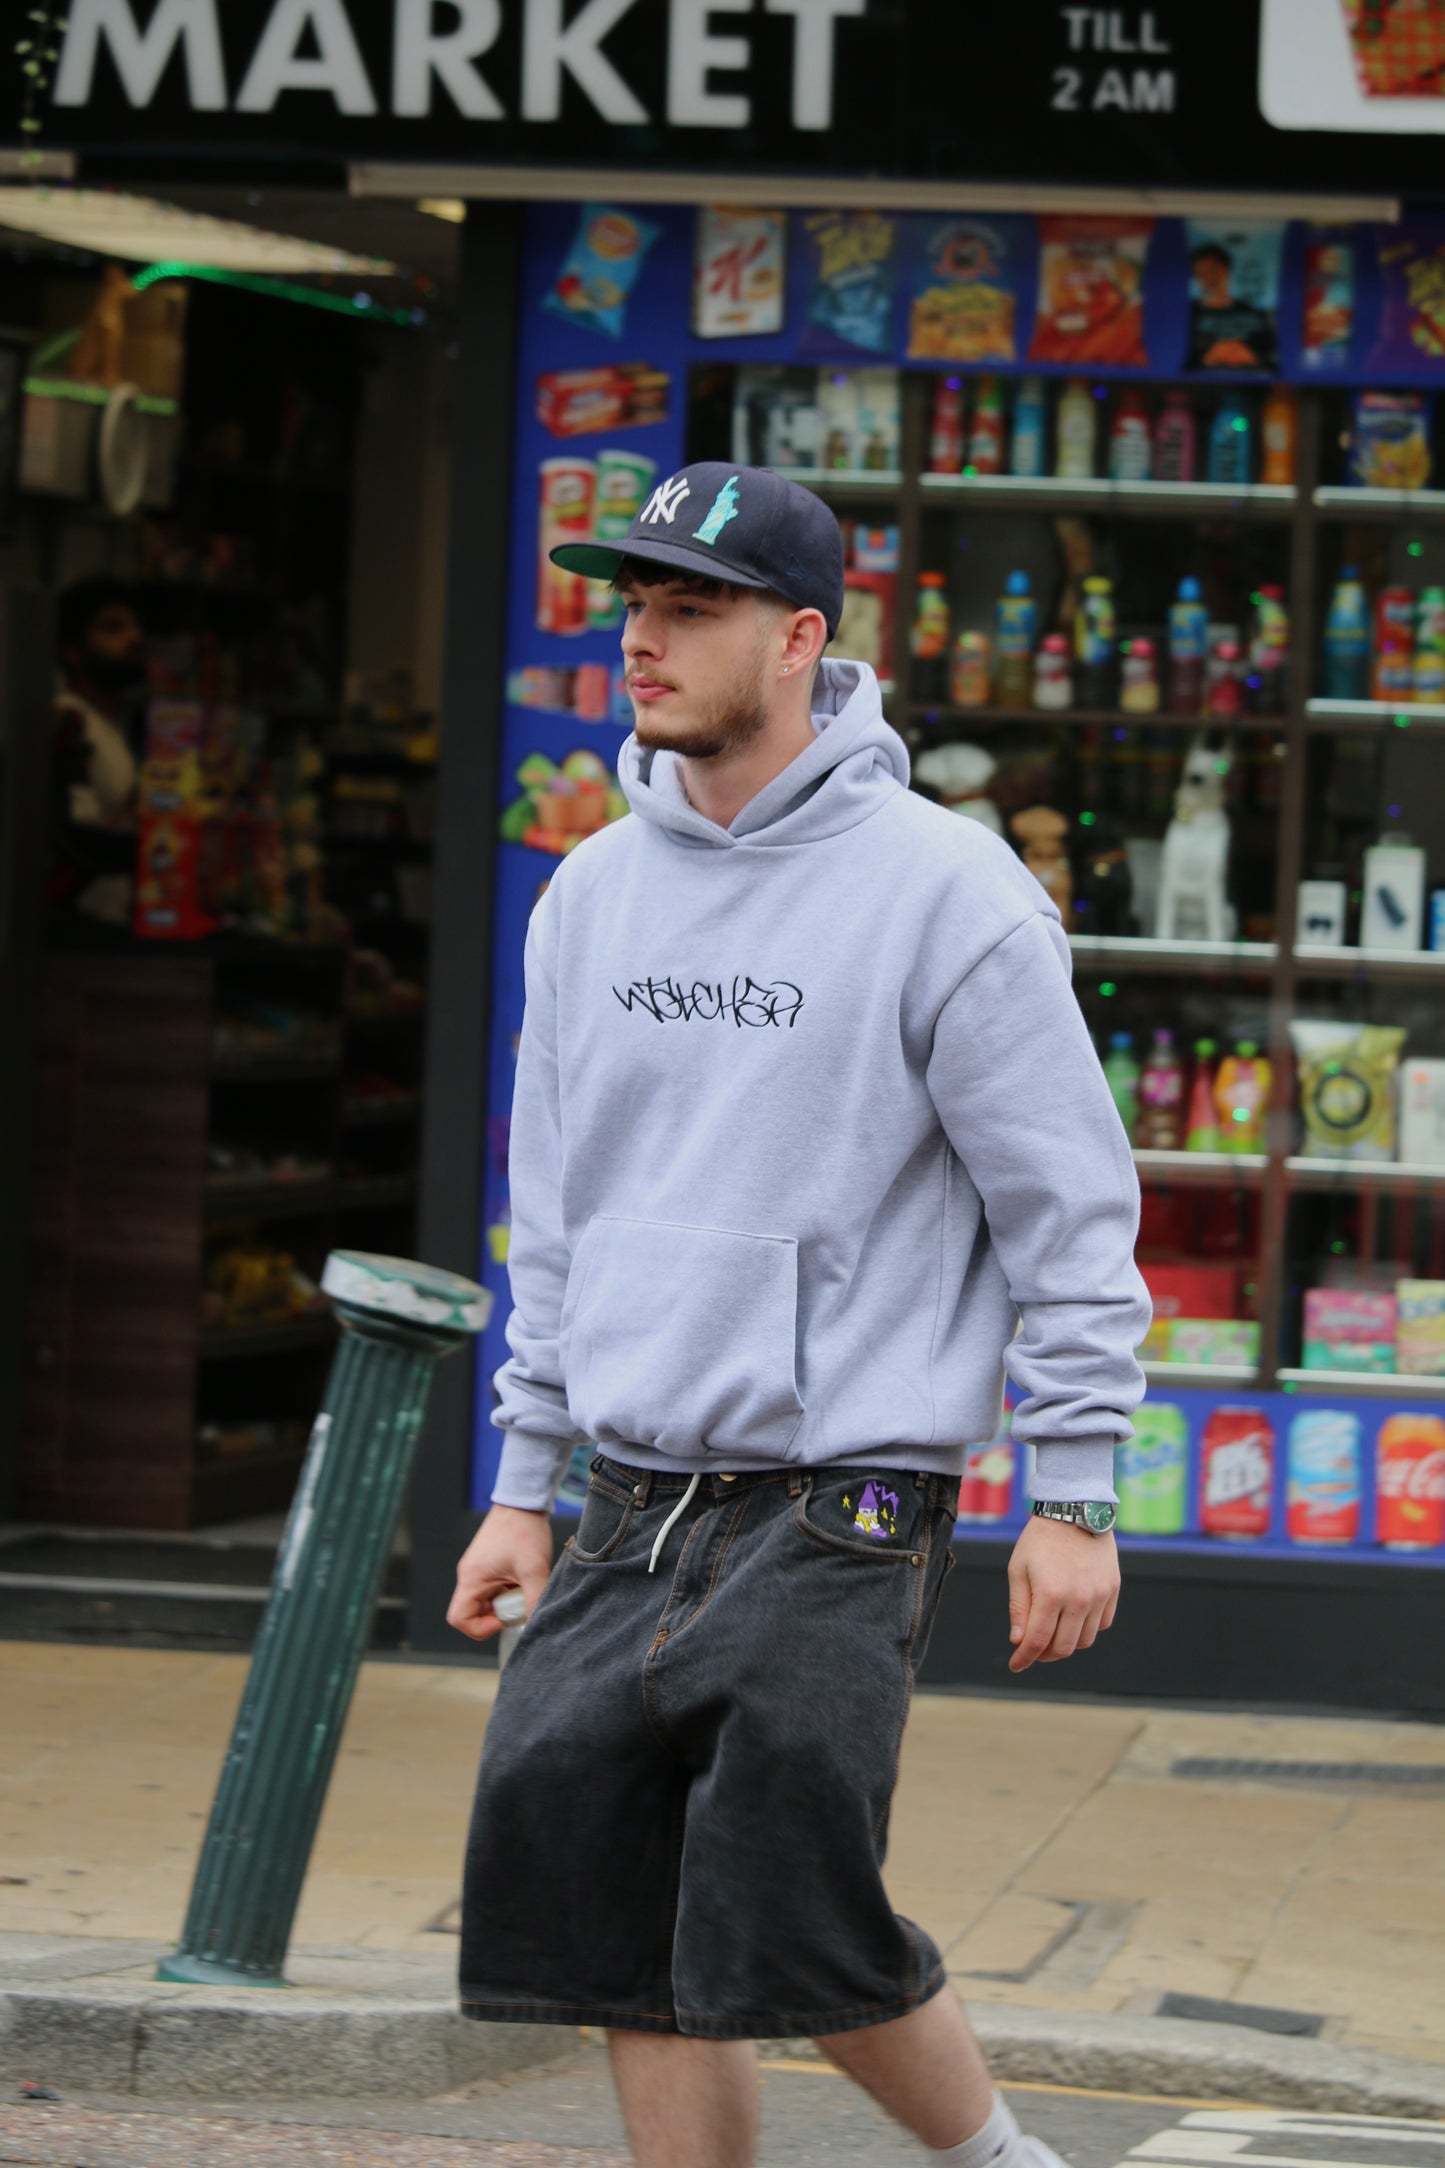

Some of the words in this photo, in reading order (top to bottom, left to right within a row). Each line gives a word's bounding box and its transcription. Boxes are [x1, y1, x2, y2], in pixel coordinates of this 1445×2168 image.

[1063, 7, 1171, 54] TILL
[52, 0, 866, 132] MARKET
[1051, 66, 1080, 110] 2
[1090, 66, 1176, 114] AM
